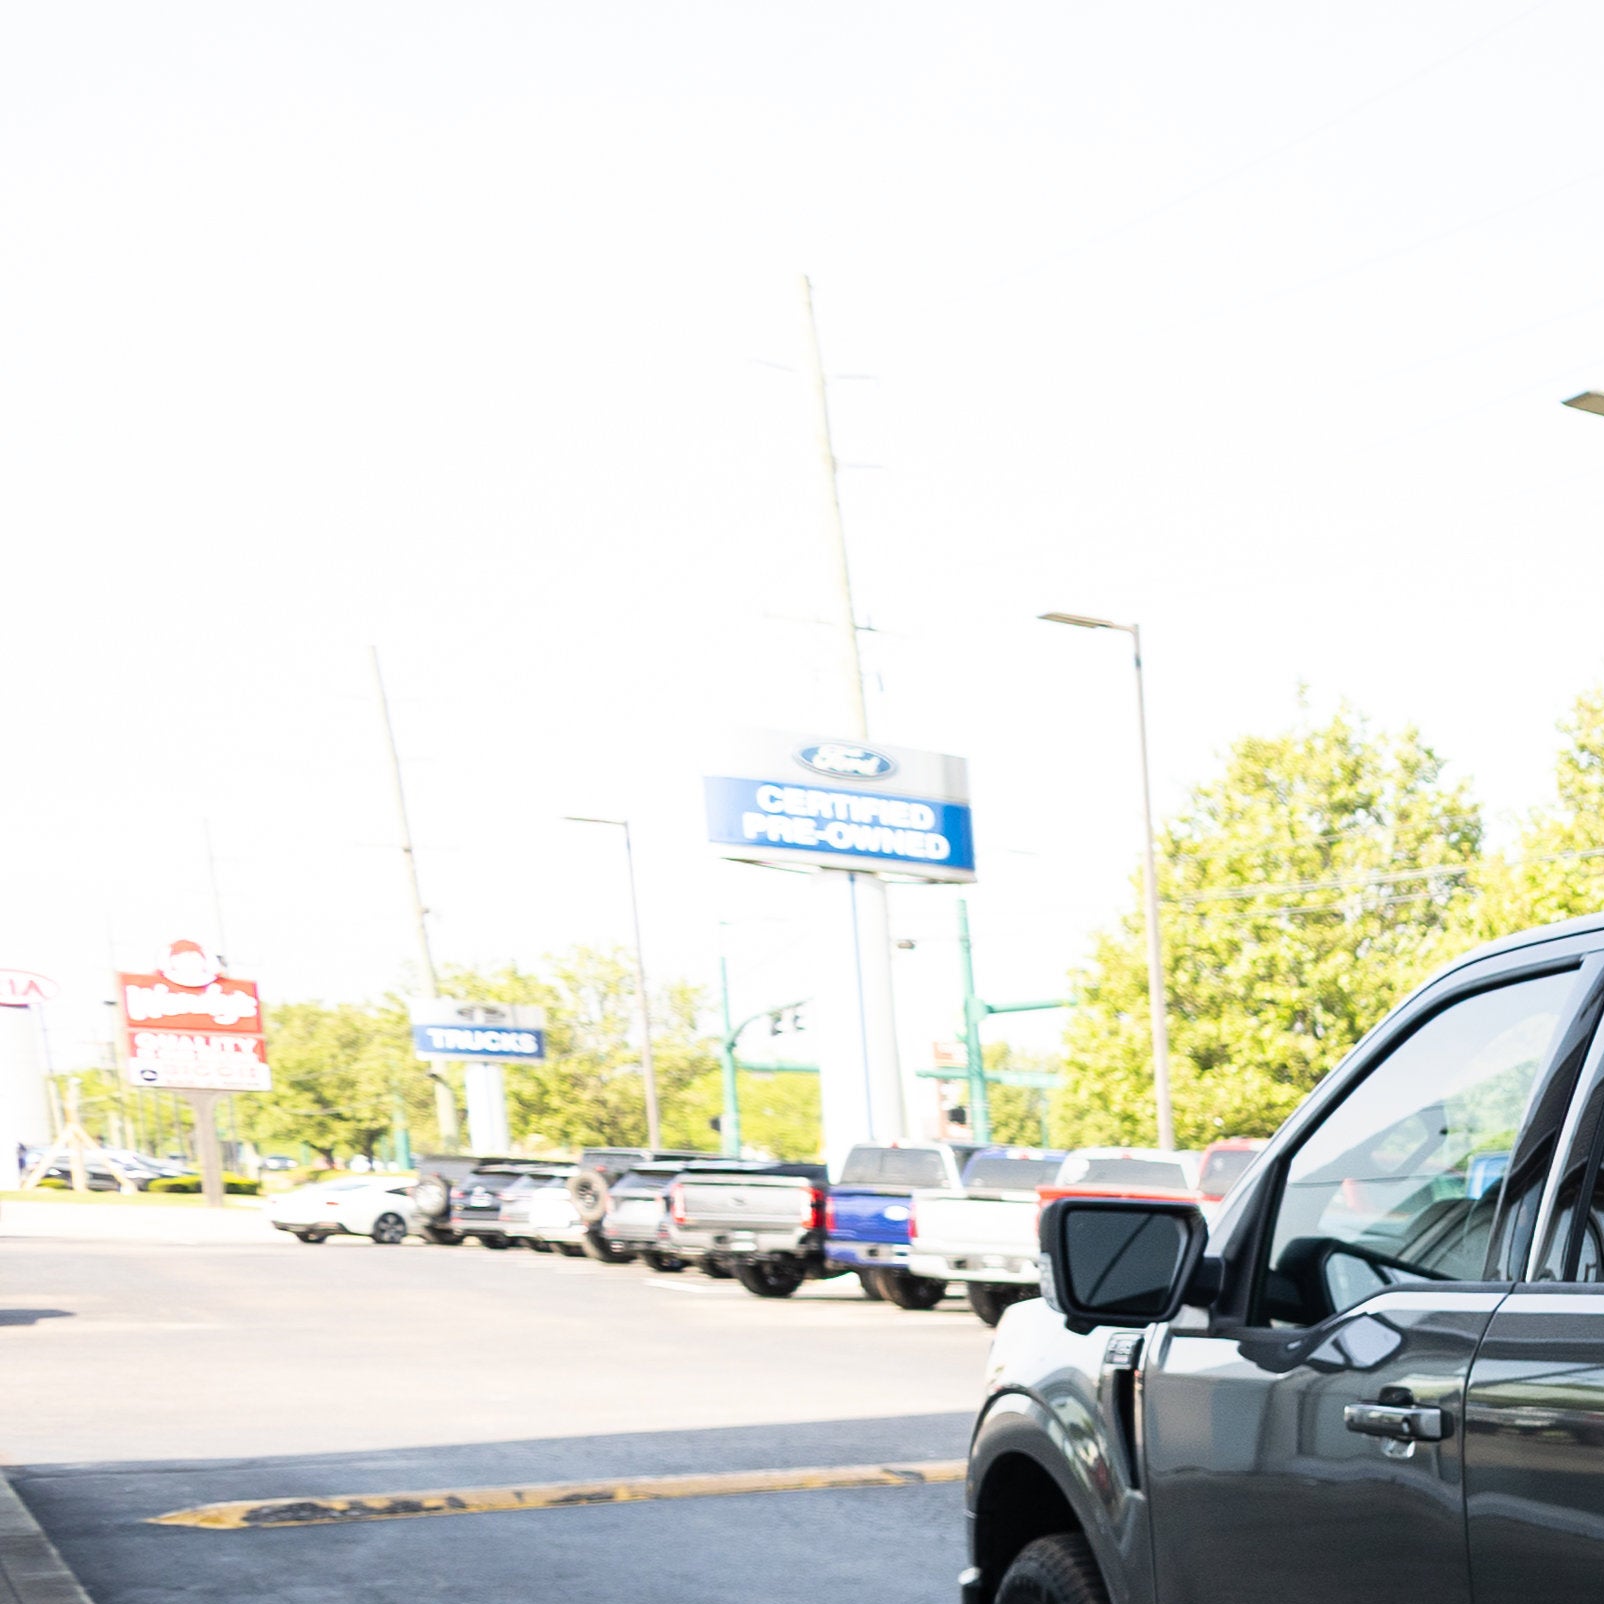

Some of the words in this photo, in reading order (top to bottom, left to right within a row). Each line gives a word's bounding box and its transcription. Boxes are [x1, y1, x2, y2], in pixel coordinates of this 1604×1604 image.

[756, 784, 935, 831] CERTIFIED
[742, 811, 951, 860] PRE-OWNED
[0, 978, 50, 1001] IA
[426, 1028, 539, 1054] TRUCKS
